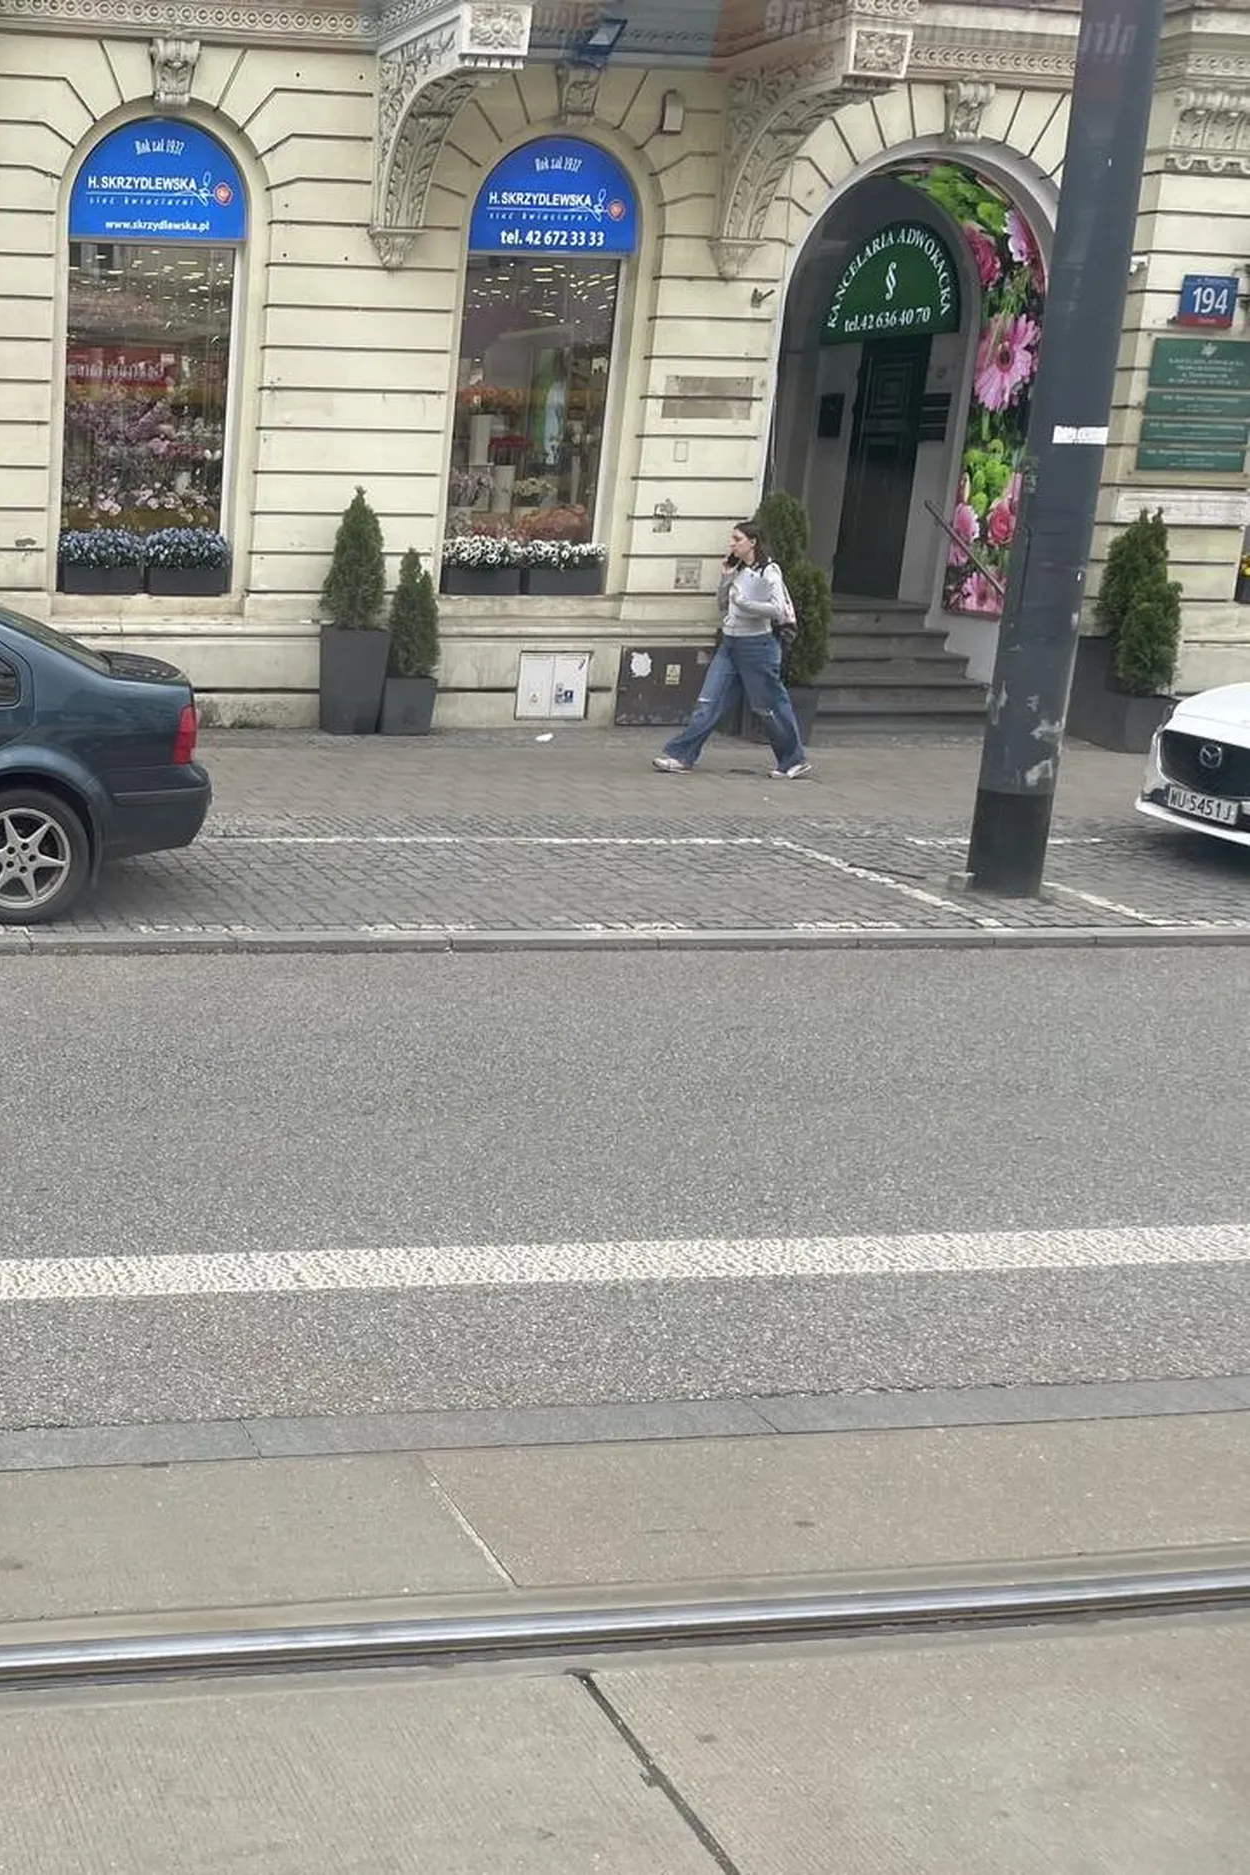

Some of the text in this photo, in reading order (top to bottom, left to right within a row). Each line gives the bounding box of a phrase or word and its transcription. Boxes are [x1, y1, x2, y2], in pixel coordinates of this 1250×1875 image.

[105, 220, 210, 233] www.skrzydlewska.pl
[500, 228, 604, 247] tel. 42 672 33 33
[827, 227, 950, 328] KANCELARIA ADWOKACKA
[1192, 286, 1229, 315] 194
[875, 310, 897, 329] 636
[898, 308, 914, 326] 40
[916, 306, 932, 323] 70
